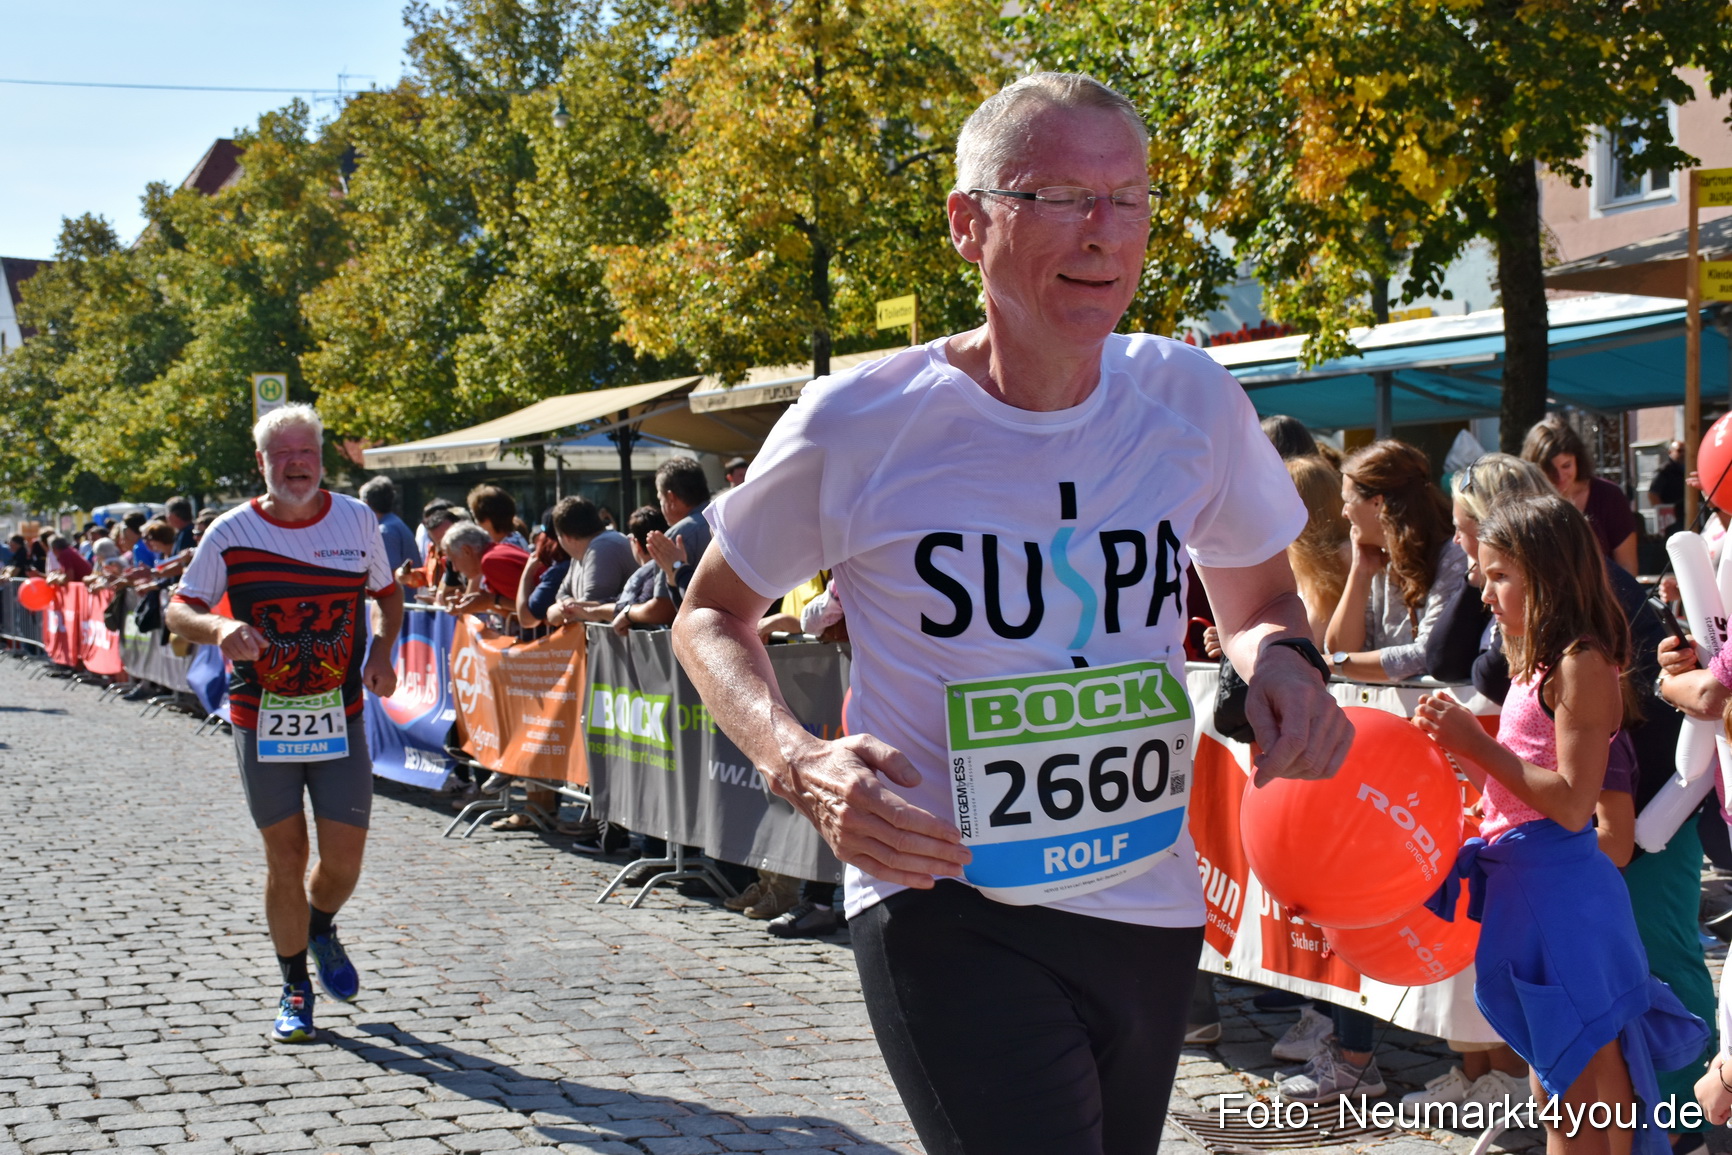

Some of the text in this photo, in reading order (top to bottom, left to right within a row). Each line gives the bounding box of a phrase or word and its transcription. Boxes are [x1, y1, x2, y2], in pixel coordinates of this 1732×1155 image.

[314, 549, 360, 558] NEUMARKT
[914, 515, 1182, 652] SUSPA
[268, 712, 334, 737] 2321
[591, 689, 667, 743] BOCK
[968, 673, 1169, 735] BOCK
[277, 741, 330, 754] STEFAN
[1175, 738, 1184, 750] D
[984, 738, 1170, 829] 2660
[1356, 783, 1443, 876] RÖDL
[1043, 832, 1130, 875] ROLF
[1406, 840, 1433, 882] energie
[1195, 850, 1241, 920] aun
[1290, 931, 1320, 953] Sicher
